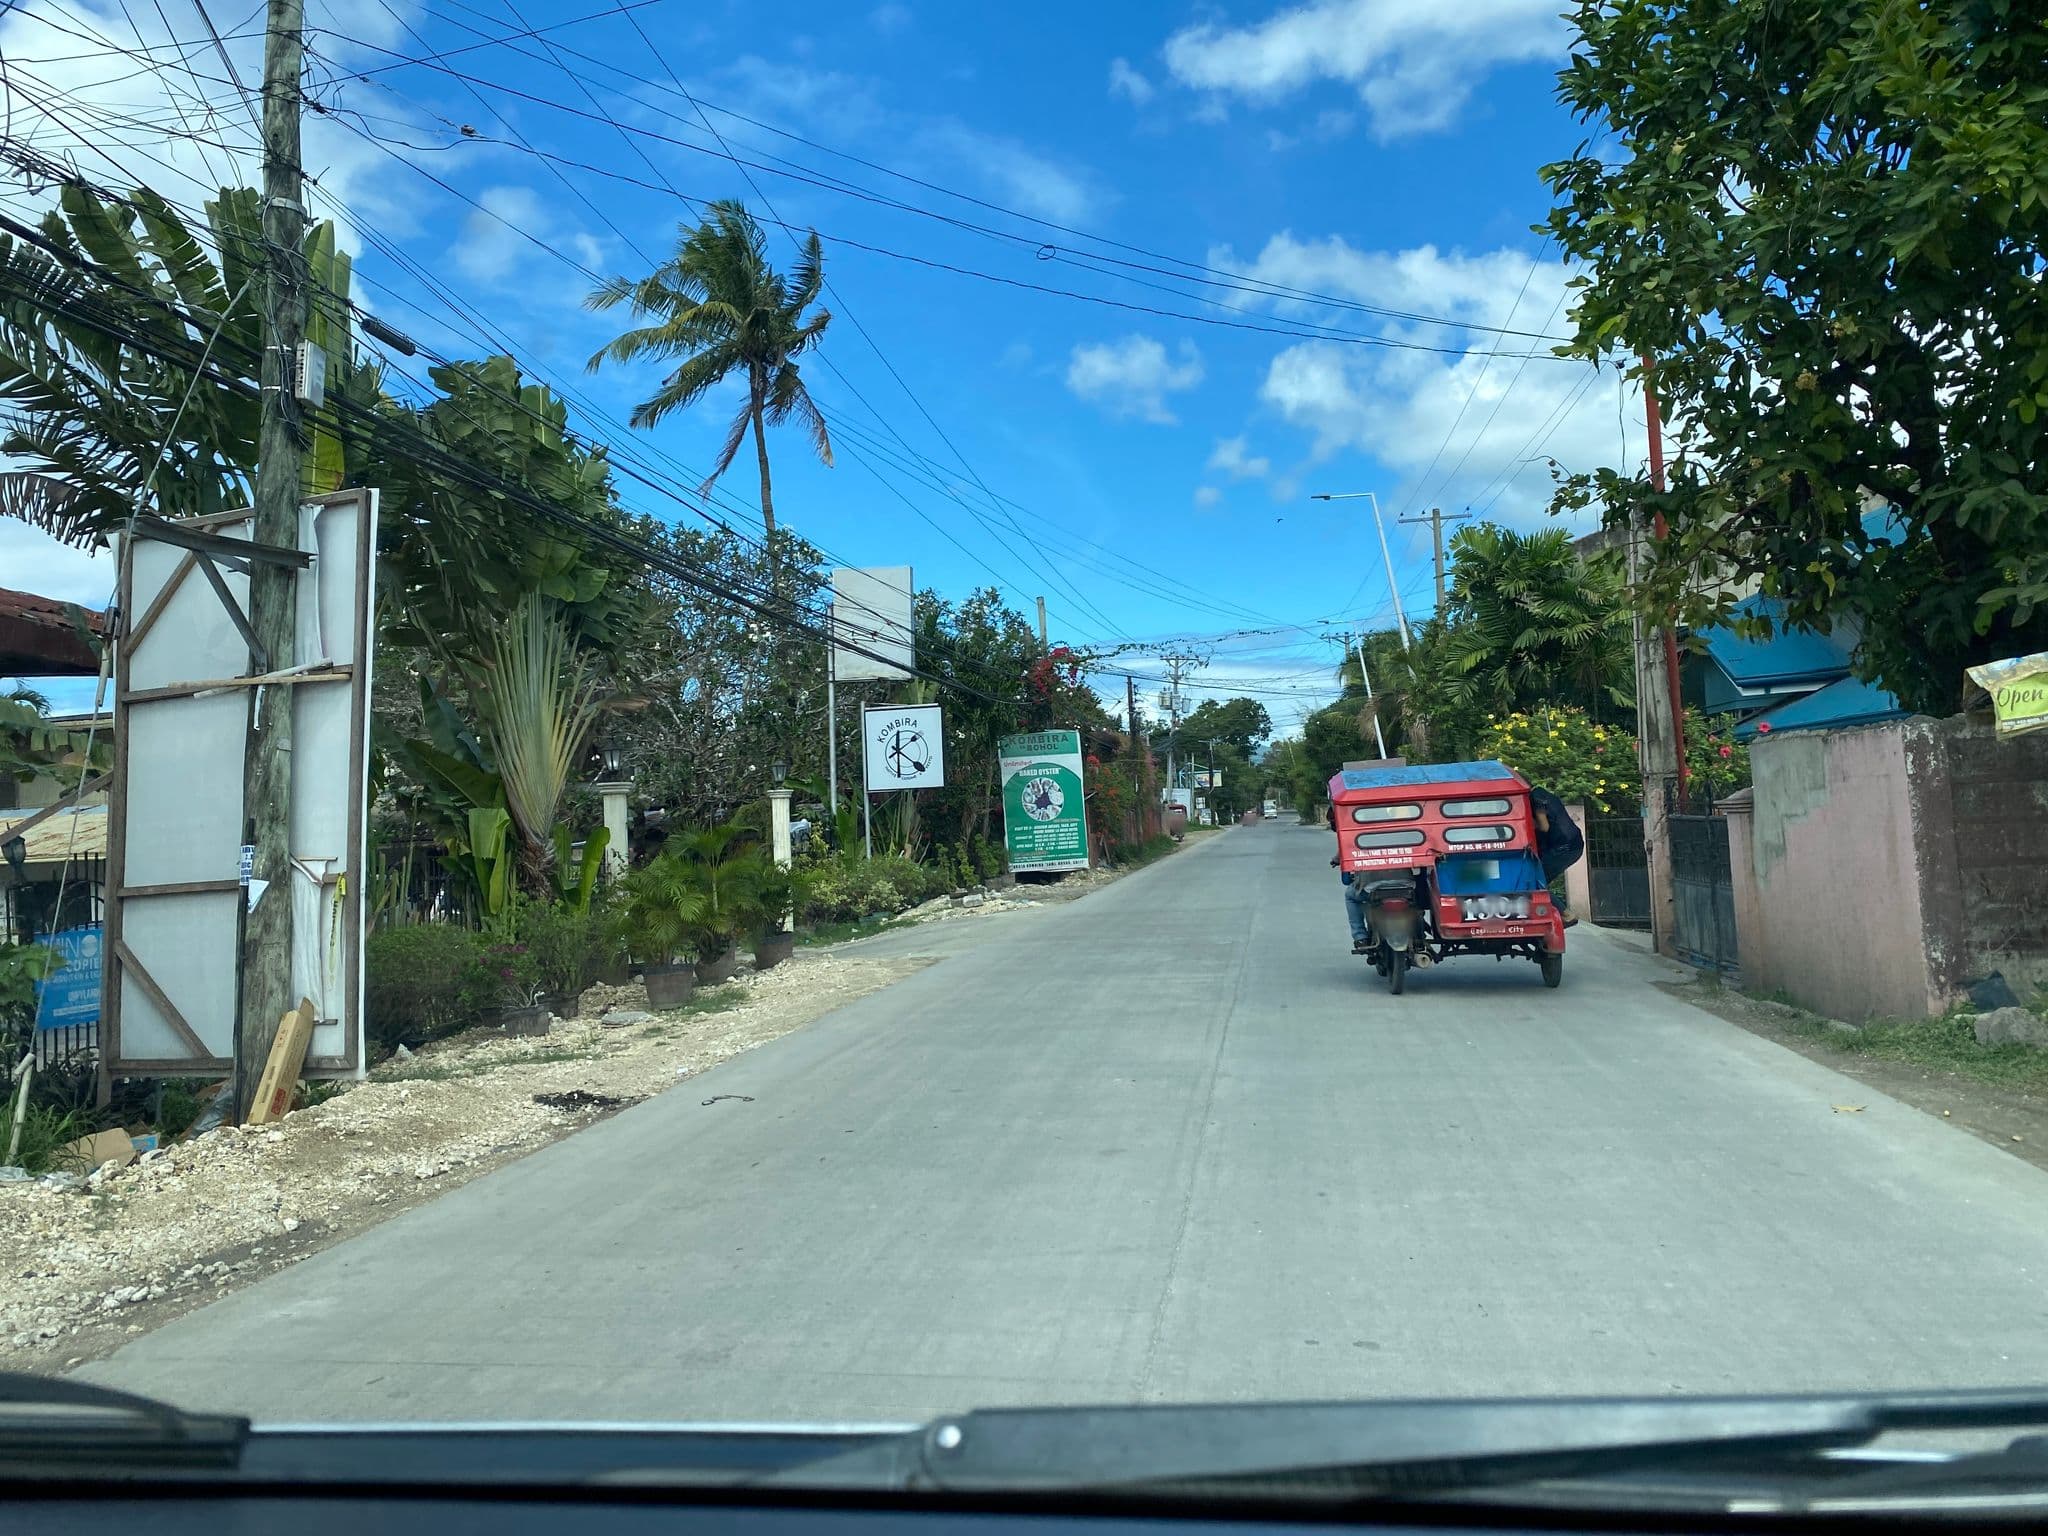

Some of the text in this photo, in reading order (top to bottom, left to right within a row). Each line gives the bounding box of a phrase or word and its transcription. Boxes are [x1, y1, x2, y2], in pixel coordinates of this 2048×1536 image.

[1997, 687, 2044, 712] Open
[876, 717, 918, 743] KOMBIRA
[1007, 734, 1069, 745] KOMBIRA
[1027, 743, 1059, 751] BOHOL
[1508, 925, 1525, 935] City
